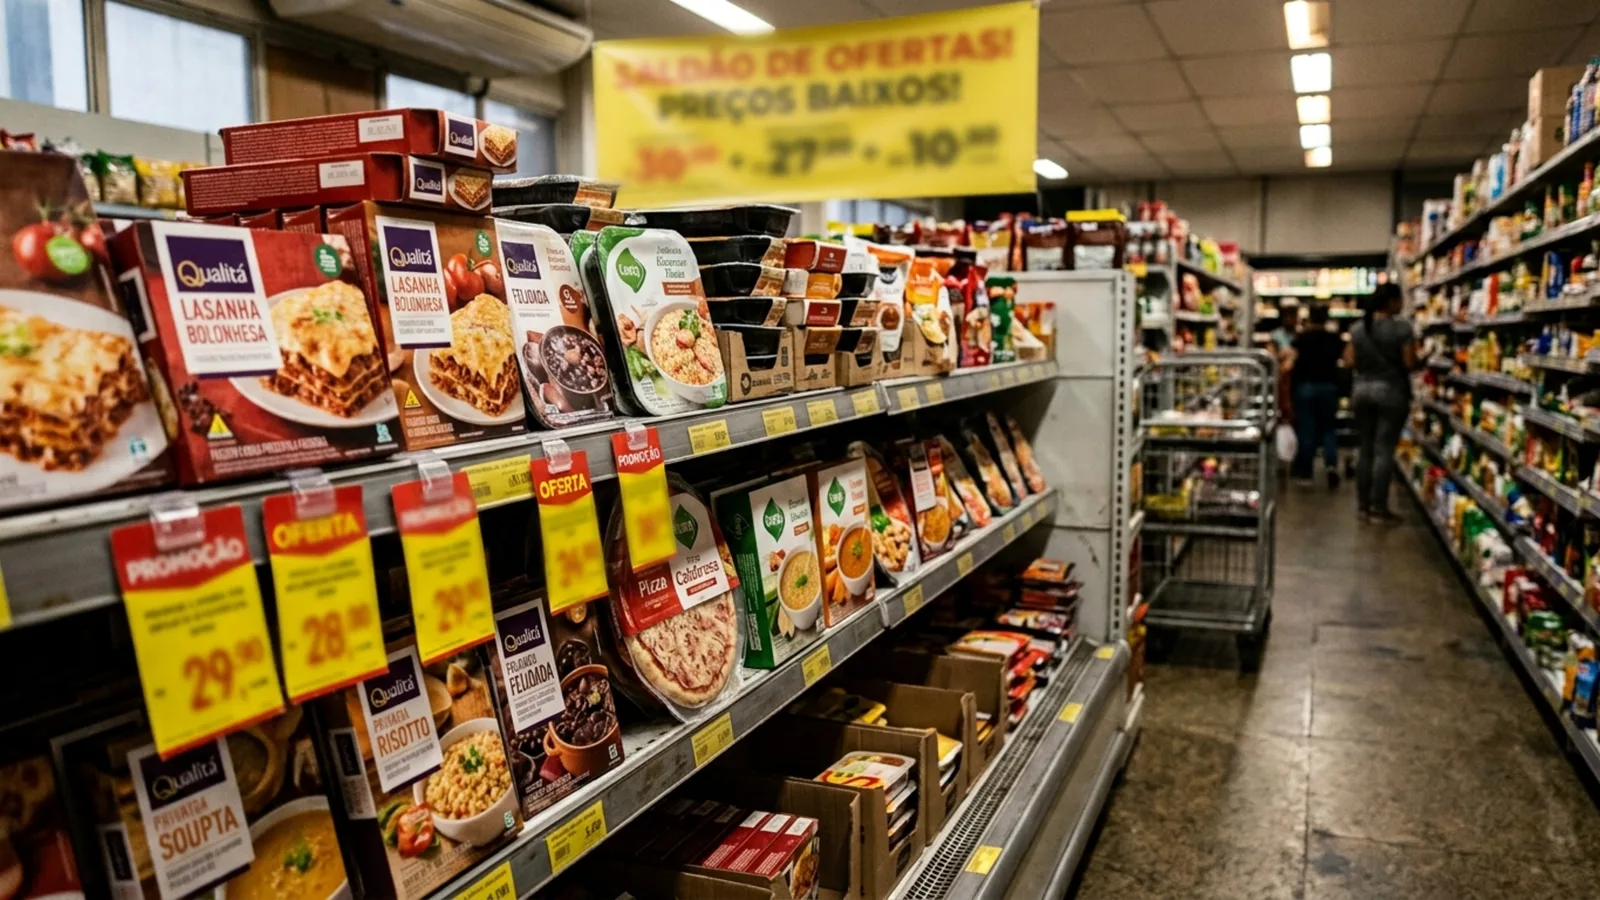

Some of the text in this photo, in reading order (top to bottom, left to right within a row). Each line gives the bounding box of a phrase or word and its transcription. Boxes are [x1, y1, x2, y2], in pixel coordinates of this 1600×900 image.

[614, 28, 1014, 89] SALDÃO DE OFERTAS!
[657, 73, 962, 122] PREÇOS BAIXOS!
[177, 260, 248, 287] Qualitá
[390, 246, 432, 267] Qualitá
[391, 276, 441, 293] LASANHA
[180, 298, 261, 321] LASANHA
[186, 324, 268, 344] BOLONHESA
[539, 472, 588, 499] OFERTA
[272, 511, 360, 549] OFERTA
[125, 537, 244, 585] PROMOÇÃO
[302, 612, 346, 668] 28
[183, 647, 234, 712] 29
[370, 674, 415, 707] Qualitá
[376, 716, 430, 758] RISOTTO
[152, 756, 218, 800] Qualitá
[159, 805, 239, 861] SOUPTA
